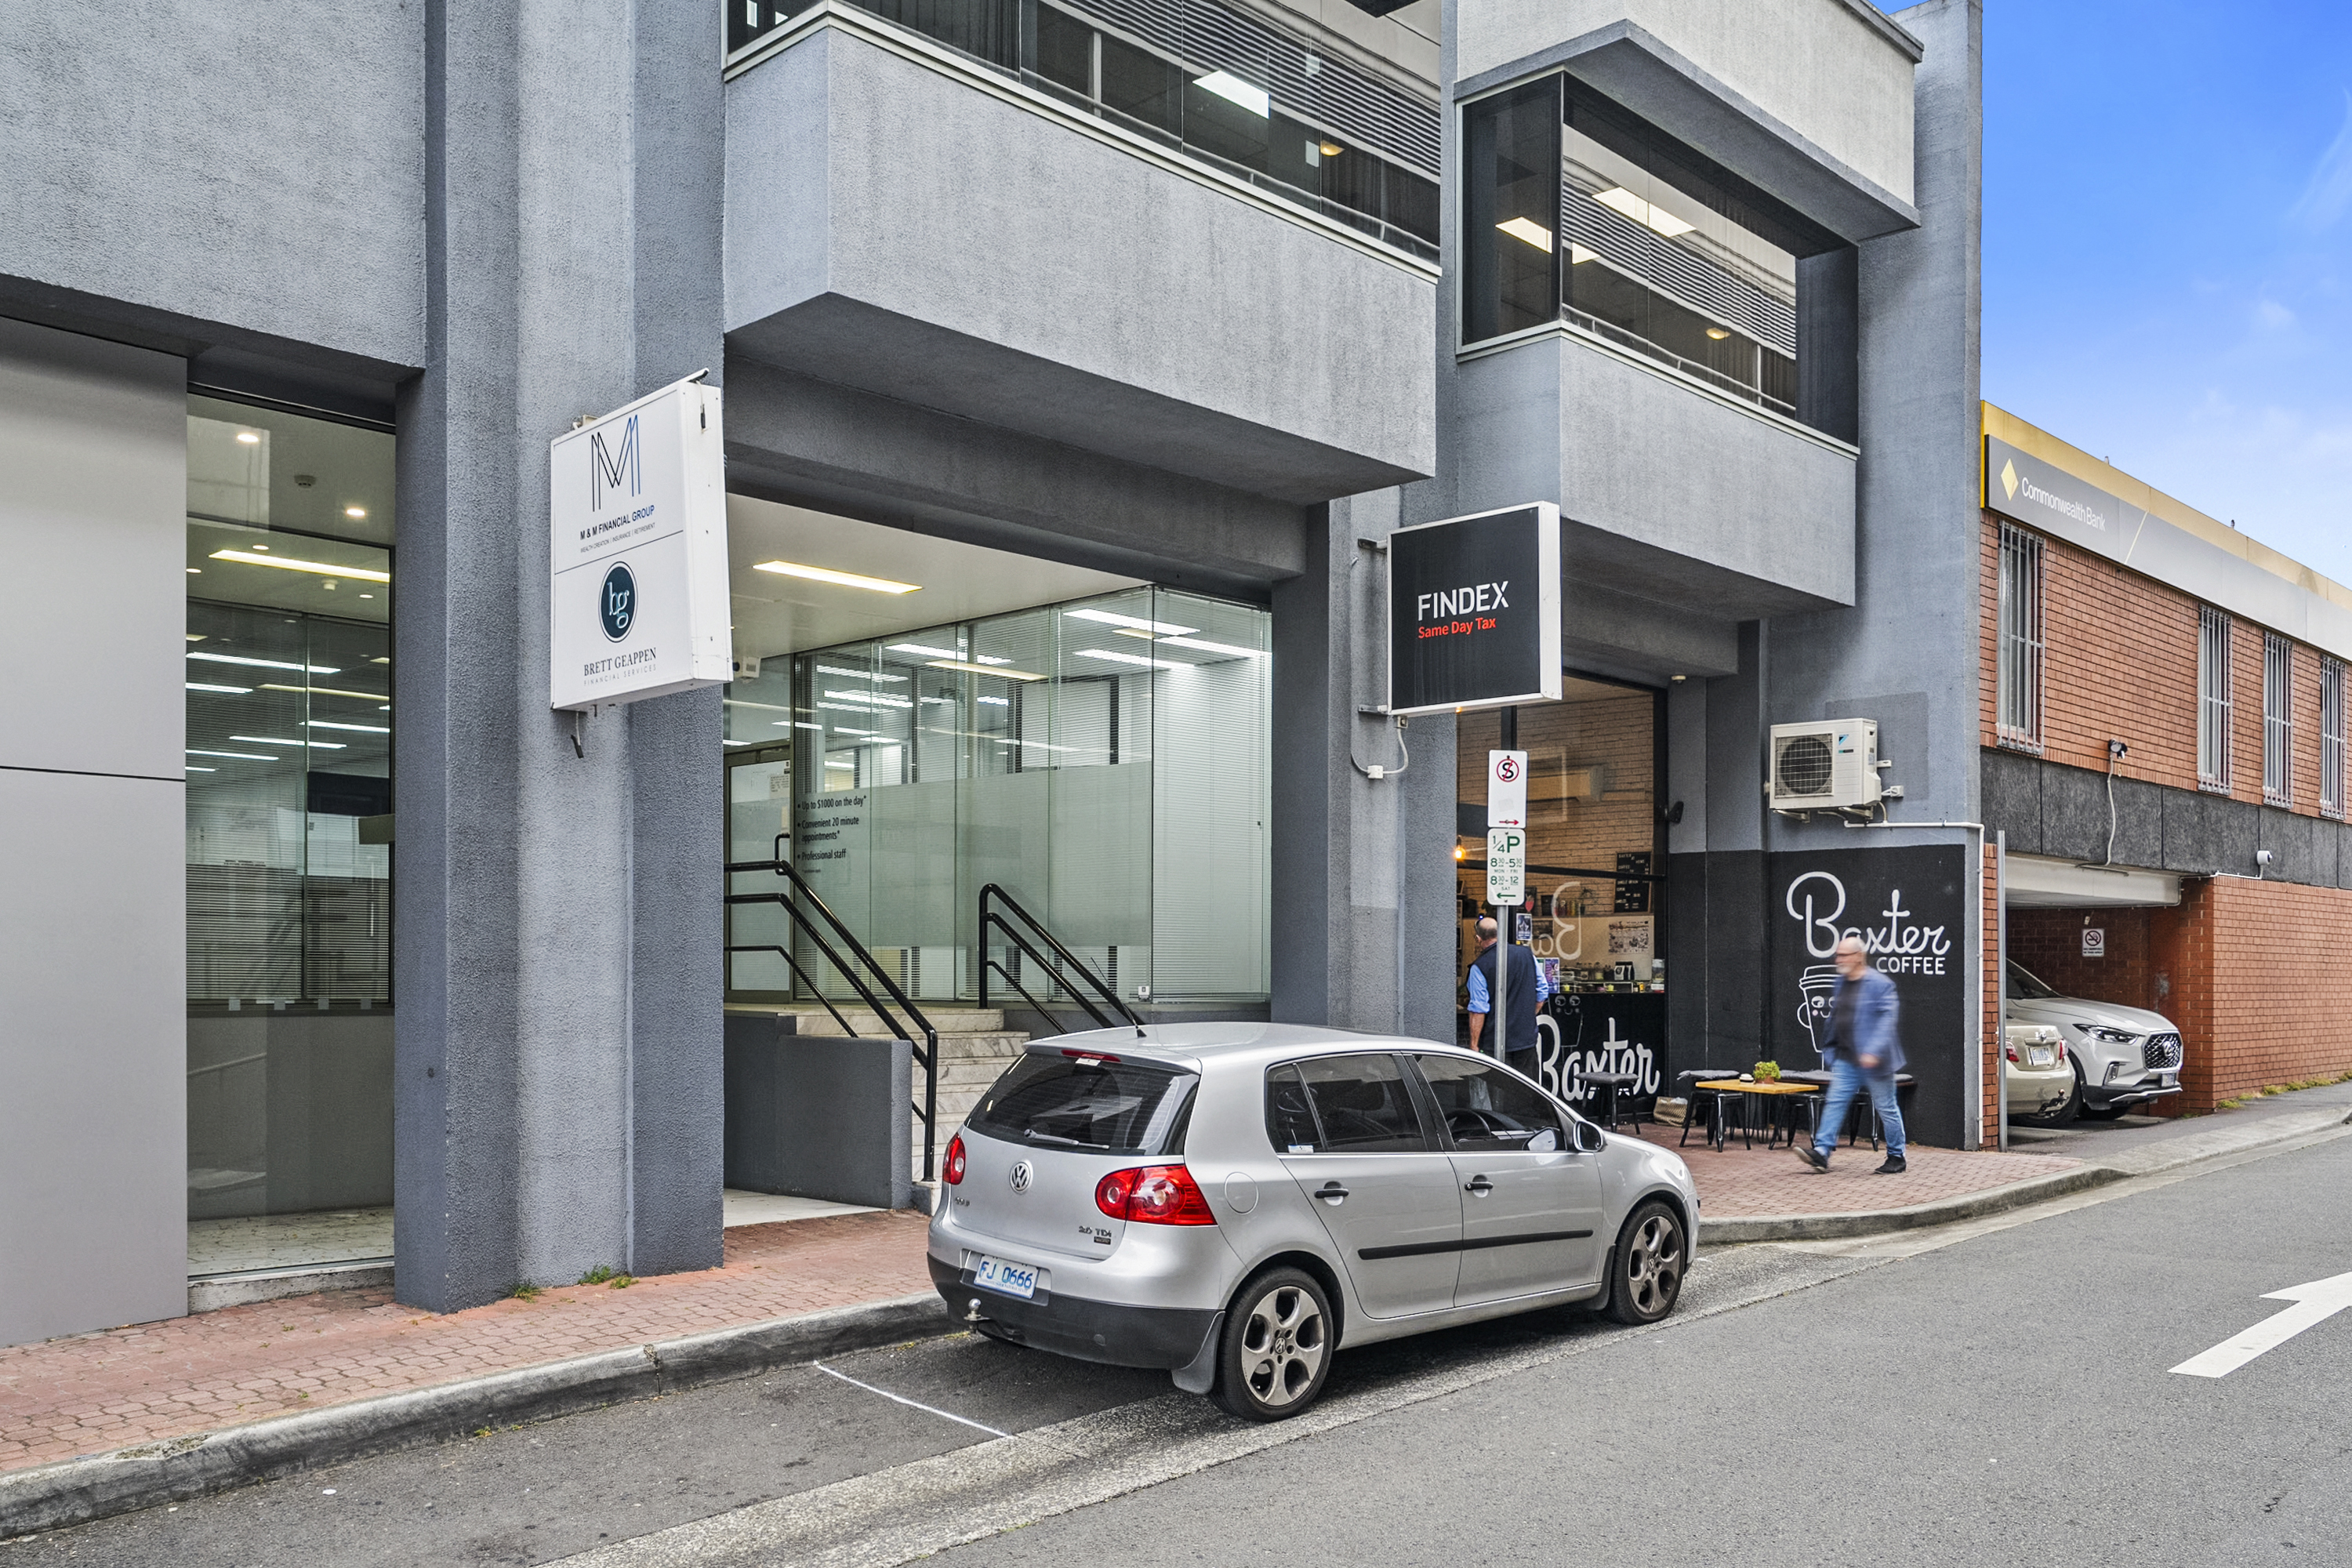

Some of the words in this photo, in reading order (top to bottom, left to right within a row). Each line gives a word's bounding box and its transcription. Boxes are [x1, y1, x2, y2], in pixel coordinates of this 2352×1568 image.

[2022, 477, 2085, 523] Commonwealth
[2086, 506, 2106, 532] Bank
[580, 530, 586, 540] M
[586, 528, 591, 539] &
[592, 525, 597, 536] M
[599, 514, 631, 534] FINANCIAL
[632, 505, 655, 521] GROUP
[612, 531, 631, 543] INSURANCE
[634, 522, 655, 535] RETIREMENT
[1418, 581, 1509, 621] FINDEX
[1418, 626, 1449, 639] Same
[1451, 621, 1473, 635] Day
[1475, 617, 1497, 630] Tax
[584, 659, 612, 677] BRETT
[615, 647, 656, 669] GEAPPEN
[584, 673, 619, 686] FINANCIAL
[623, 664, 656, 677] SERVICES
[802, 801, 810, 811] Up
[818, 798, 834, 808] $1000
[844, 797, 852, 806] the
[801, 818, 831, 829] Convenient
[832, 817, 839, 826] 20
[840, 816, 859, 826] minute
[801, 849, 833, 860] Professional
[833, 848, 846, 858] staff
[1507, 836, 1520, 853] P
[1876, 956, 1945, 975] COFFEE
[978, 1261, 996, 1279] FJ
[1002, 1266, 1033, 1289] 0666
